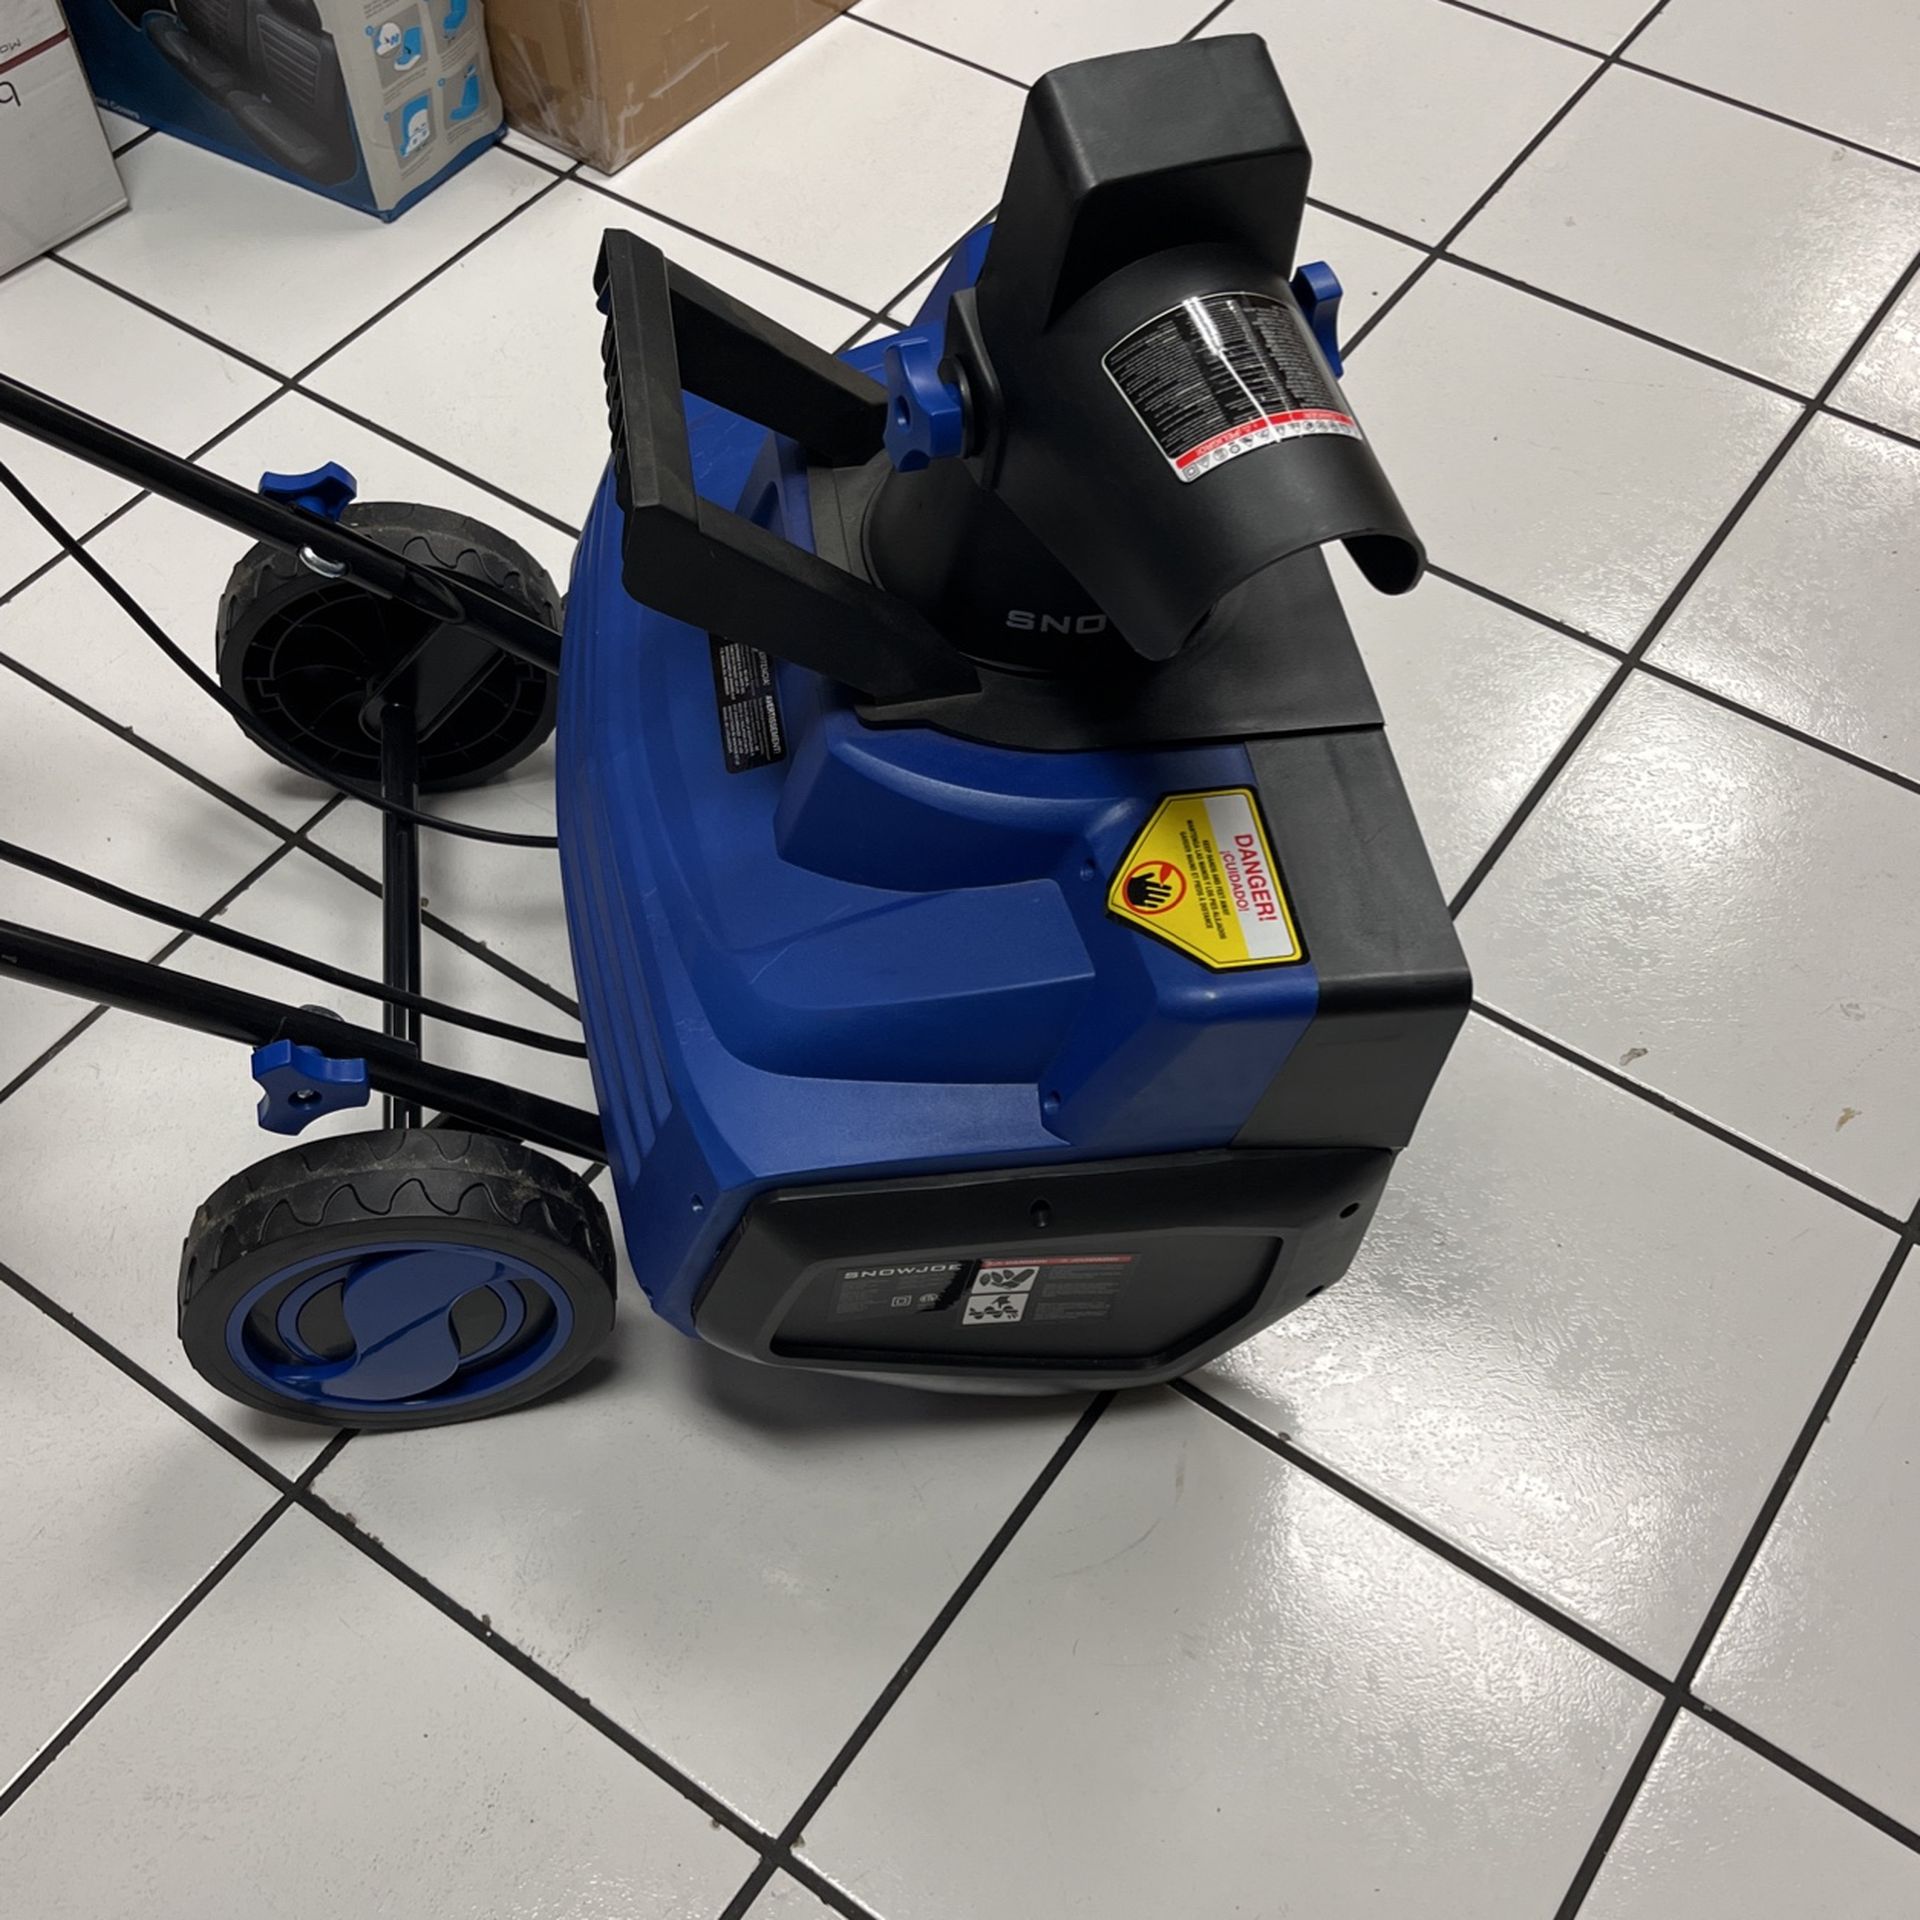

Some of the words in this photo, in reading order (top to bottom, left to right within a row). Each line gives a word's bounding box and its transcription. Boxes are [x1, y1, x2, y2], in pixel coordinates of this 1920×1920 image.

[1221, 851, 1249, 911] ¡CUIDADO!
[1234, 834, 1277, 921] DANGER!
[845, 1264, 960, 1279] SNOWJOE
